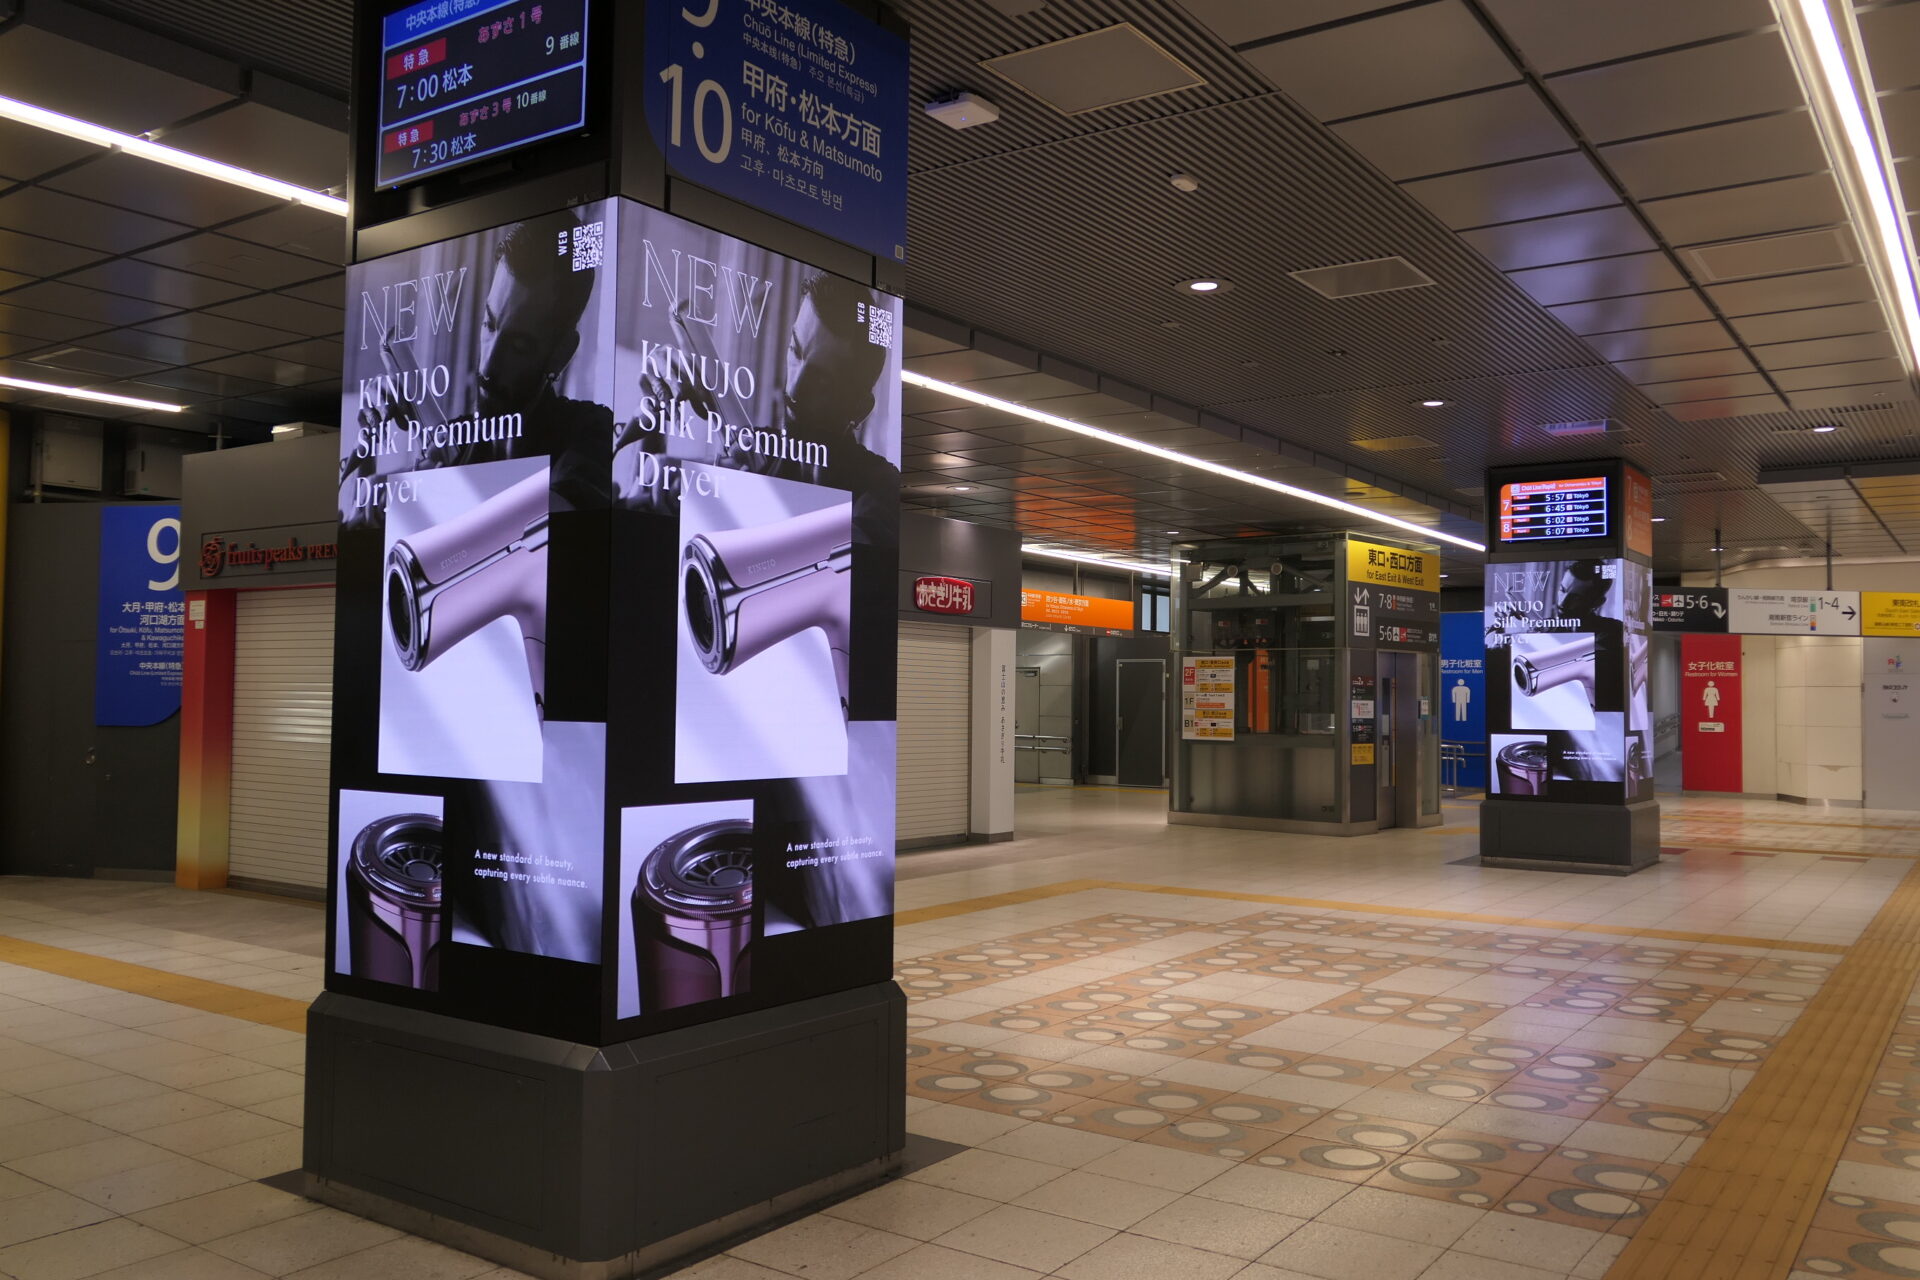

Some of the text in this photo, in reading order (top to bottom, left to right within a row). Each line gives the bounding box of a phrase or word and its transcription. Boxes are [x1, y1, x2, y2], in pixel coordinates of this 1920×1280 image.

[403, 48, 430, 71] 特急
[743, 14, 772, 38] Chūō
[774, 30, 796, 51] Line
[798, 43, 836, 73] (Limited
[838, 64, 878, 98] Express)
[397, 64, 474, 109] 7:00 松本
[659, 63, 733, 164] 10
[743, 60, 882, 158] 甲府・松本方面
[397, 128, 420, 146] 特急
[740, 101, 883, 183] for Kōfu & Matsumoto
[412, 132, 477, 169] 7:30 松本
[821, 187, 843, 212] 방면
[558, 230, 568, 256] WEB
[642, 239, 773, 338] NEW
[360, 267, 467, 350] NEW
[857, 301, 865, 324] WEB
[640, 339, 756, 400] KINUJO
[358, 364, 450, 410] KINUJO
[356, 411, 523, 460] Silk Premium
[638, 395, 829, 468] Silk Premium
[638, 451, 727, 500] Dryer
[355, 475, 423, 512] Dryer
[1503, 500, 1510, 511] 7
[1545, 493, 1565, 502] 5:57
[1545, 504, 1566, 513] 6:45
[1545, 516, 1566, 525] 6:02
[1503, 523, 1510, 533] 8
[1545, 527, 1566, 536] 6:07
[147, 517, 181, 591] 9
[265, 537, 303, 570] peaks
[1368, 548, 1423, 574] 東口・西口方面
[1375, 571, 1387, 581] East
[1387, 572, 1397, 583] Exit
[1397, 574, 1402, 583] &
[1402, 575, 1414, 585] West
[1414, 576, 1424, 586] Exit
[1493, 571, 1550, 593] NEW
[916, 579, 972, 611] あさぎり牛乳
[1494, 600, 1544, 612] KINUJO
[1494, 616, 1581, 628] Silk Premium
[786, 843, 792, 852] A
[794, 842, 809, 851] new
[810, 839, 840, 850] standard
[474, 849, 574, 871] A new standard of beauty,
[786, 857, 819, 869] capturing
[820, 855, 839, 865] every
[474, 867, 588, 889] capturing every subtle nuance.
